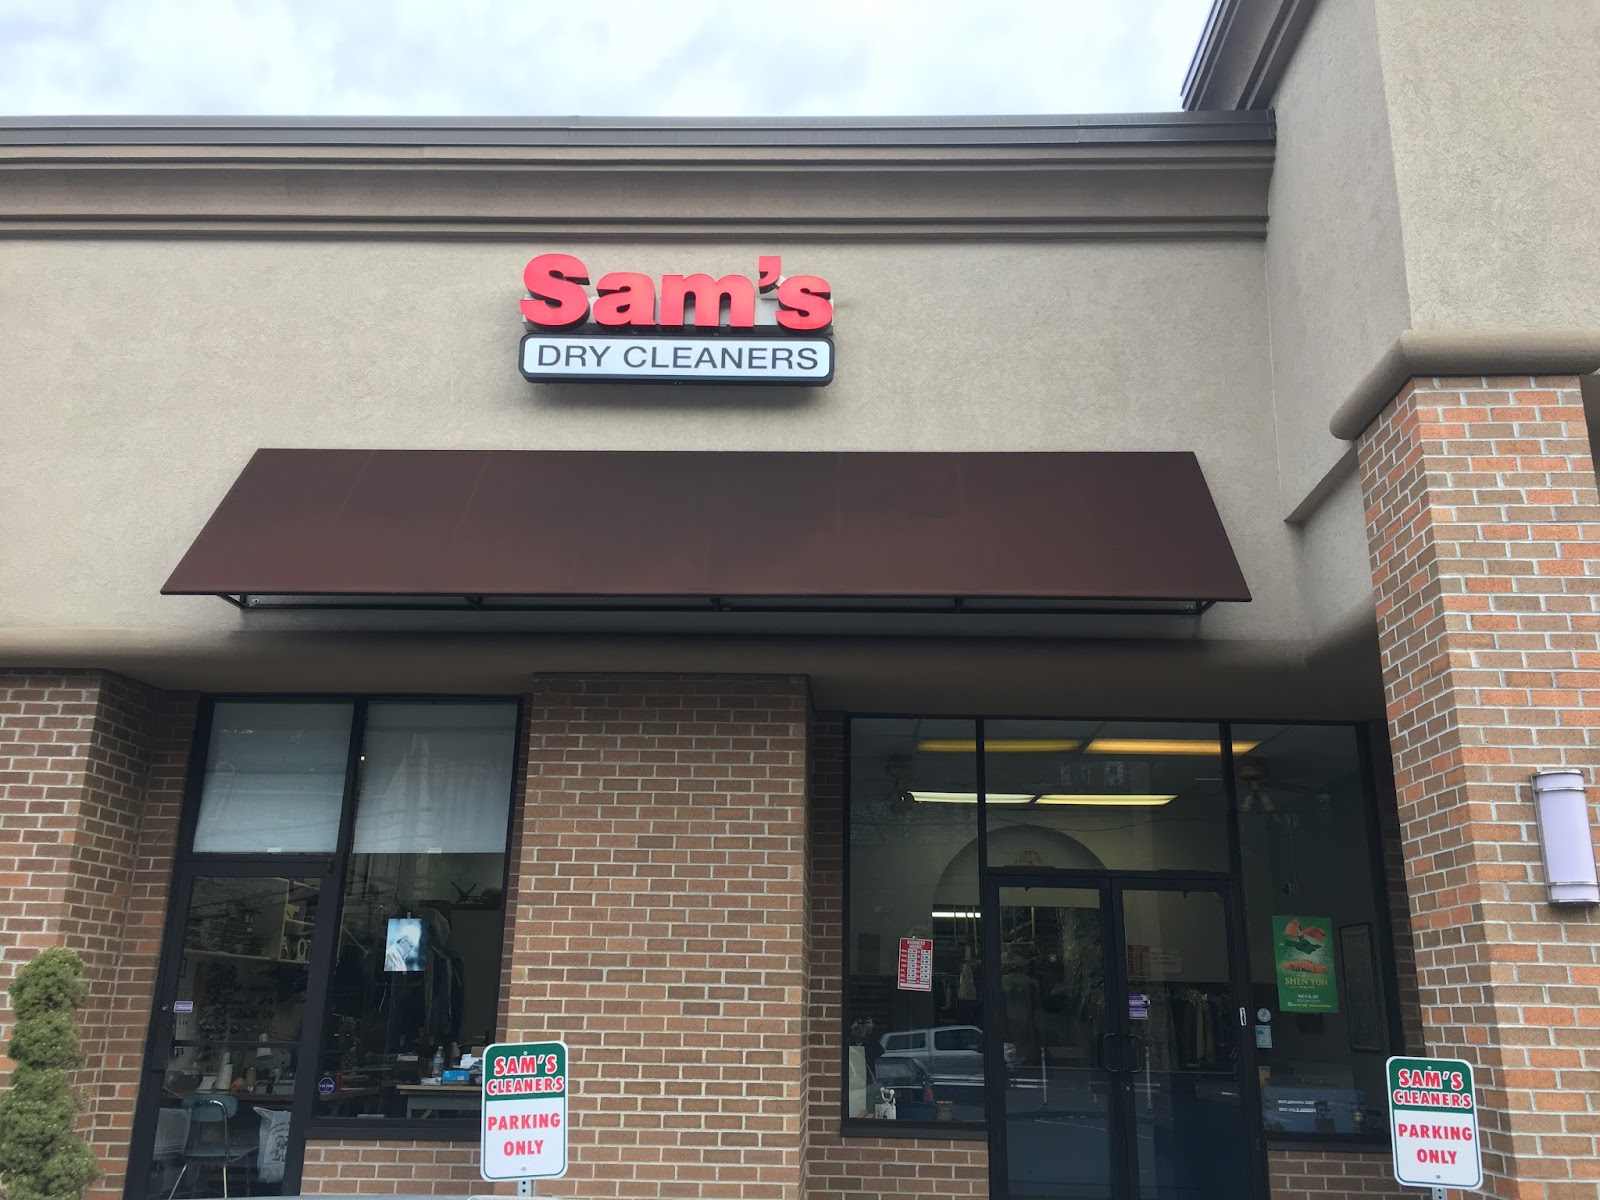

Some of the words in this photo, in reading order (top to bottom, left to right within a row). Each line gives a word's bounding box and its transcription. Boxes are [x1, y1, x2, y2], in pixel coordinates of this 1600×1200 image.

[519, 253, 834, 331] Sam's
[537, 344, 612, 367] DRY
[623, 345, 818, 370] CLEANERS
[1285, 977, 1308, 985] SHEN
[494, 1054, 557, 1076] SAM'S
[487, 1077, 564, 1095] CLEANERS
[1398, 1069, 1463, 1090] SAM'S
[1393, 1089, 1473, 1108] CLEANERS
[487, 1112, 560, 1131] PARKING
[1398, 1123, 1472, 1141] PARKING
[503, 1139, 544, 1156] ONLY
[1416, 1148, 1457, 1165] ONLY
